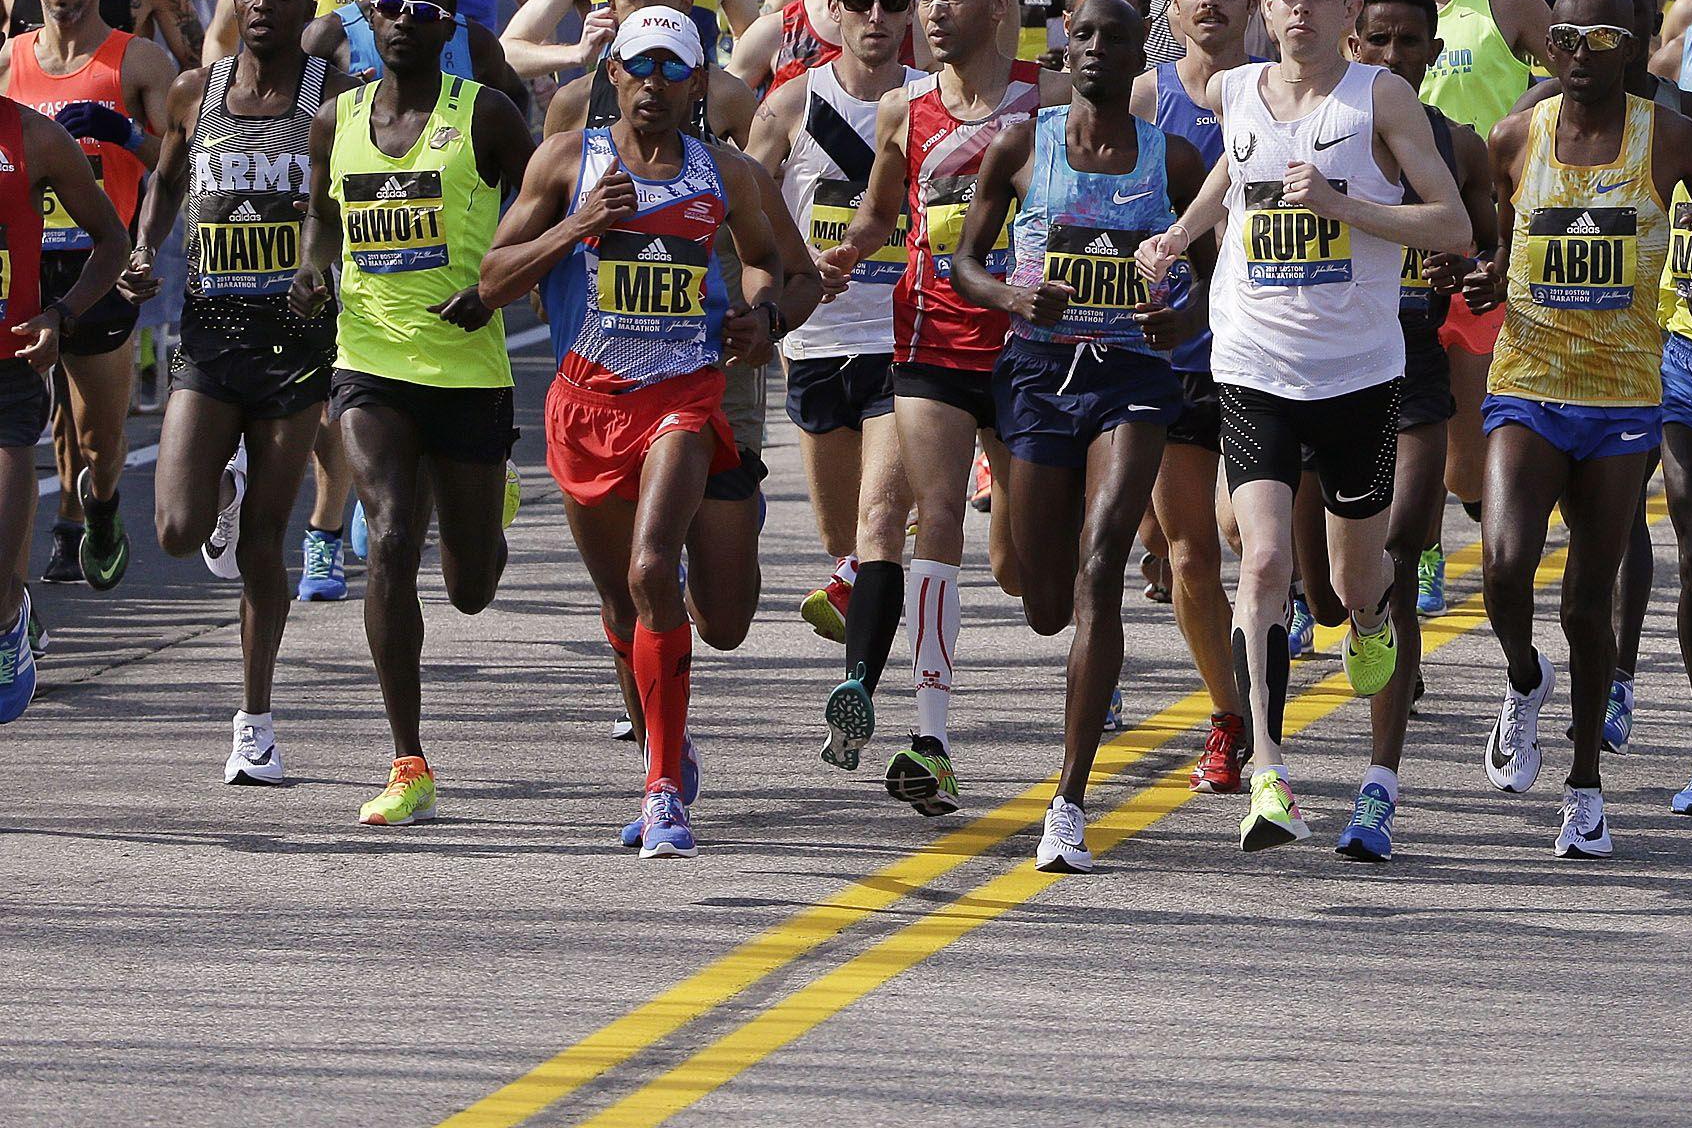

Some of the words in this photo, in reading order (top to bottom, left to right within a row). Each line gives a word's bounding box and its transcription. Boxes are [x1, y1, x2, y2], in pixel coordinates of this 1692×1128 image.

[641, 18, 682, 32] NYAC
[194, 152, 313, 194] ARMY
[376, 190, 407, 199] adidas
[229, 213, 262, 222] adidas
[347, 206, 439, 244] BIWOTT
[1567, 226, 1601, 234] adidas
[1252, 213, 1341, 261] RUPP
[201, 225, 296, 271] MAIYO
[1085, 246, 1119, 256] adidas
[638, 252, 672, 262] adidas
[1542, 239, 1623, 284] ABDI
[1049, 257, 1147, 306] KORIR
[615, 264, 693, 314] MEB
[1550, 295, 1590, 303] MARATHON
[1062, 315, 1104, 323] MARATHON
[618, 323, 660, 332] MARATHON
